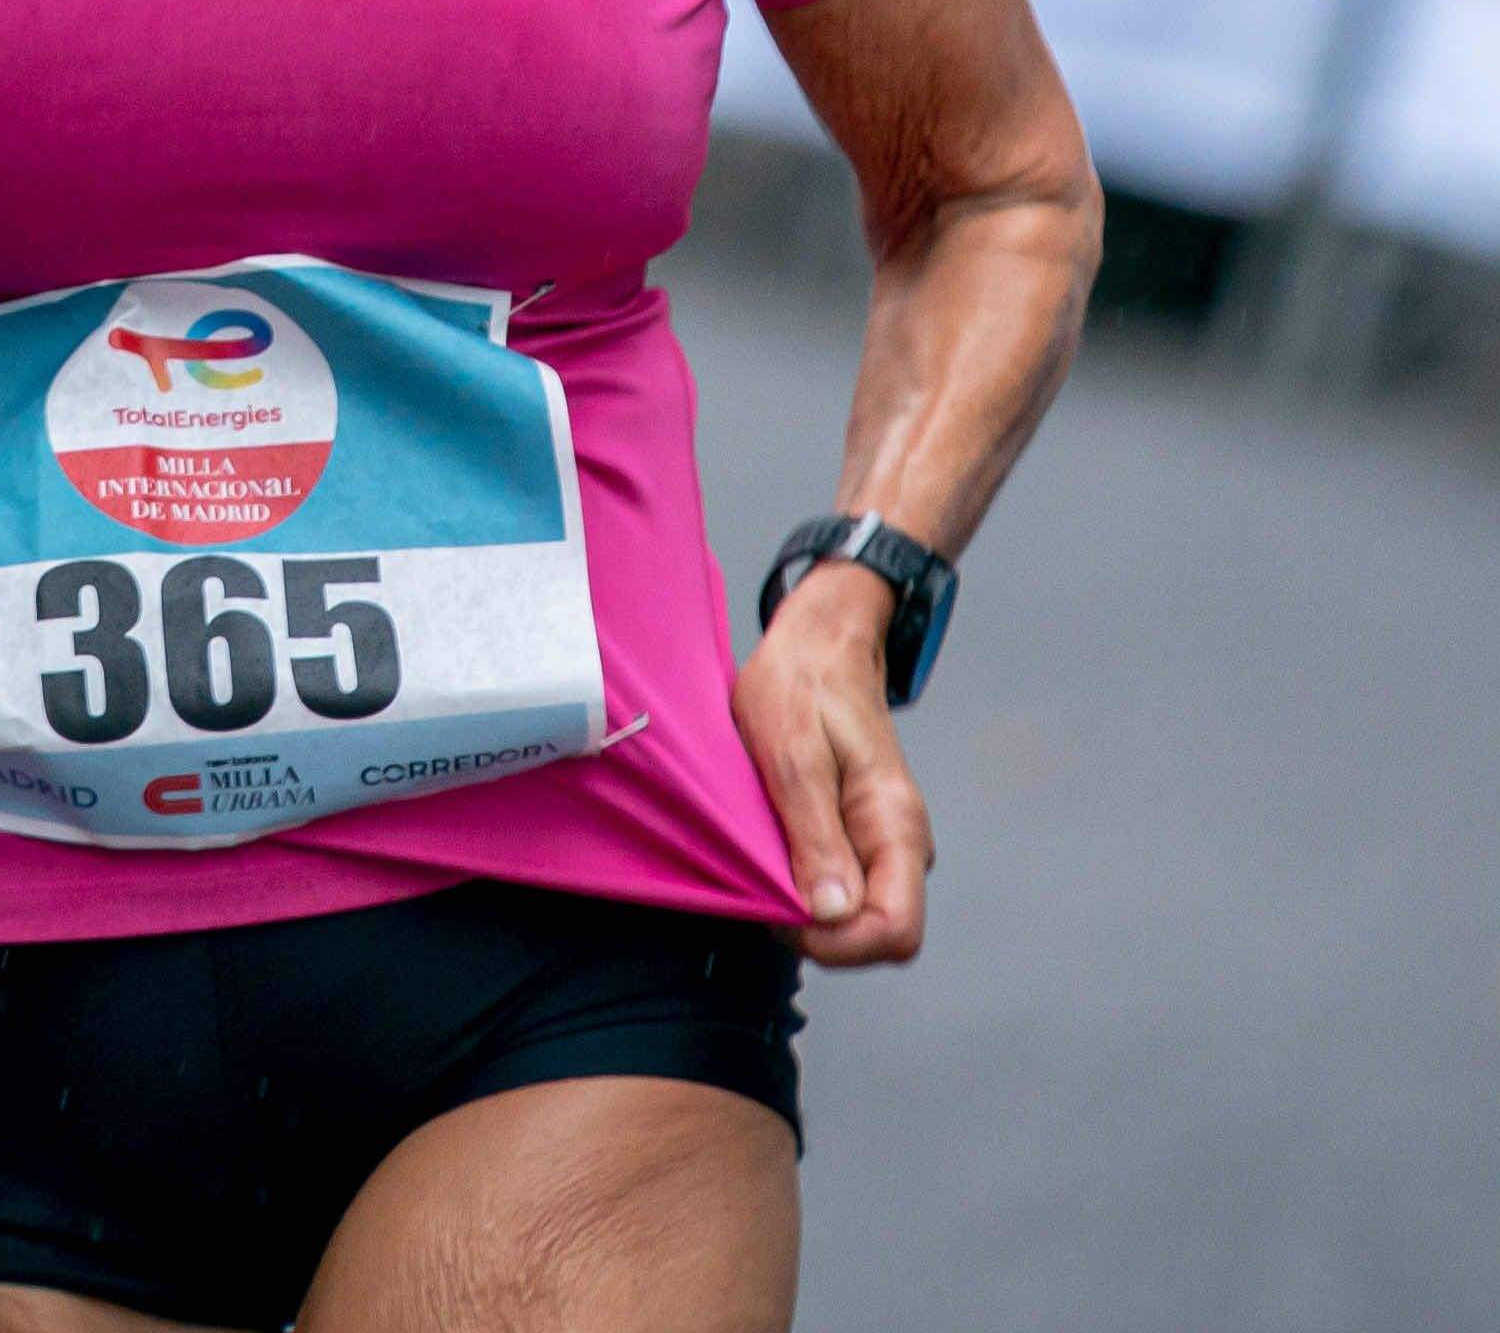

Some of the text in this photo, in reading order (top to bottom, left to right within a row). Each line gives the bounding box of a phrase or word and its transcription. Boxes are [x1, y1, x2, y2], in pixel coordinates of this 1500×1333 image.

[112, 404, 282, 431] TotalEnergies
[156, 455, 236, 476] MILLA
[130, 499, 271, 523] DE MADRID
[36, 554, 402, 745] 365
[209, 765, 300, 790] MILLA
[211, 786, 317, 814] URBANA
